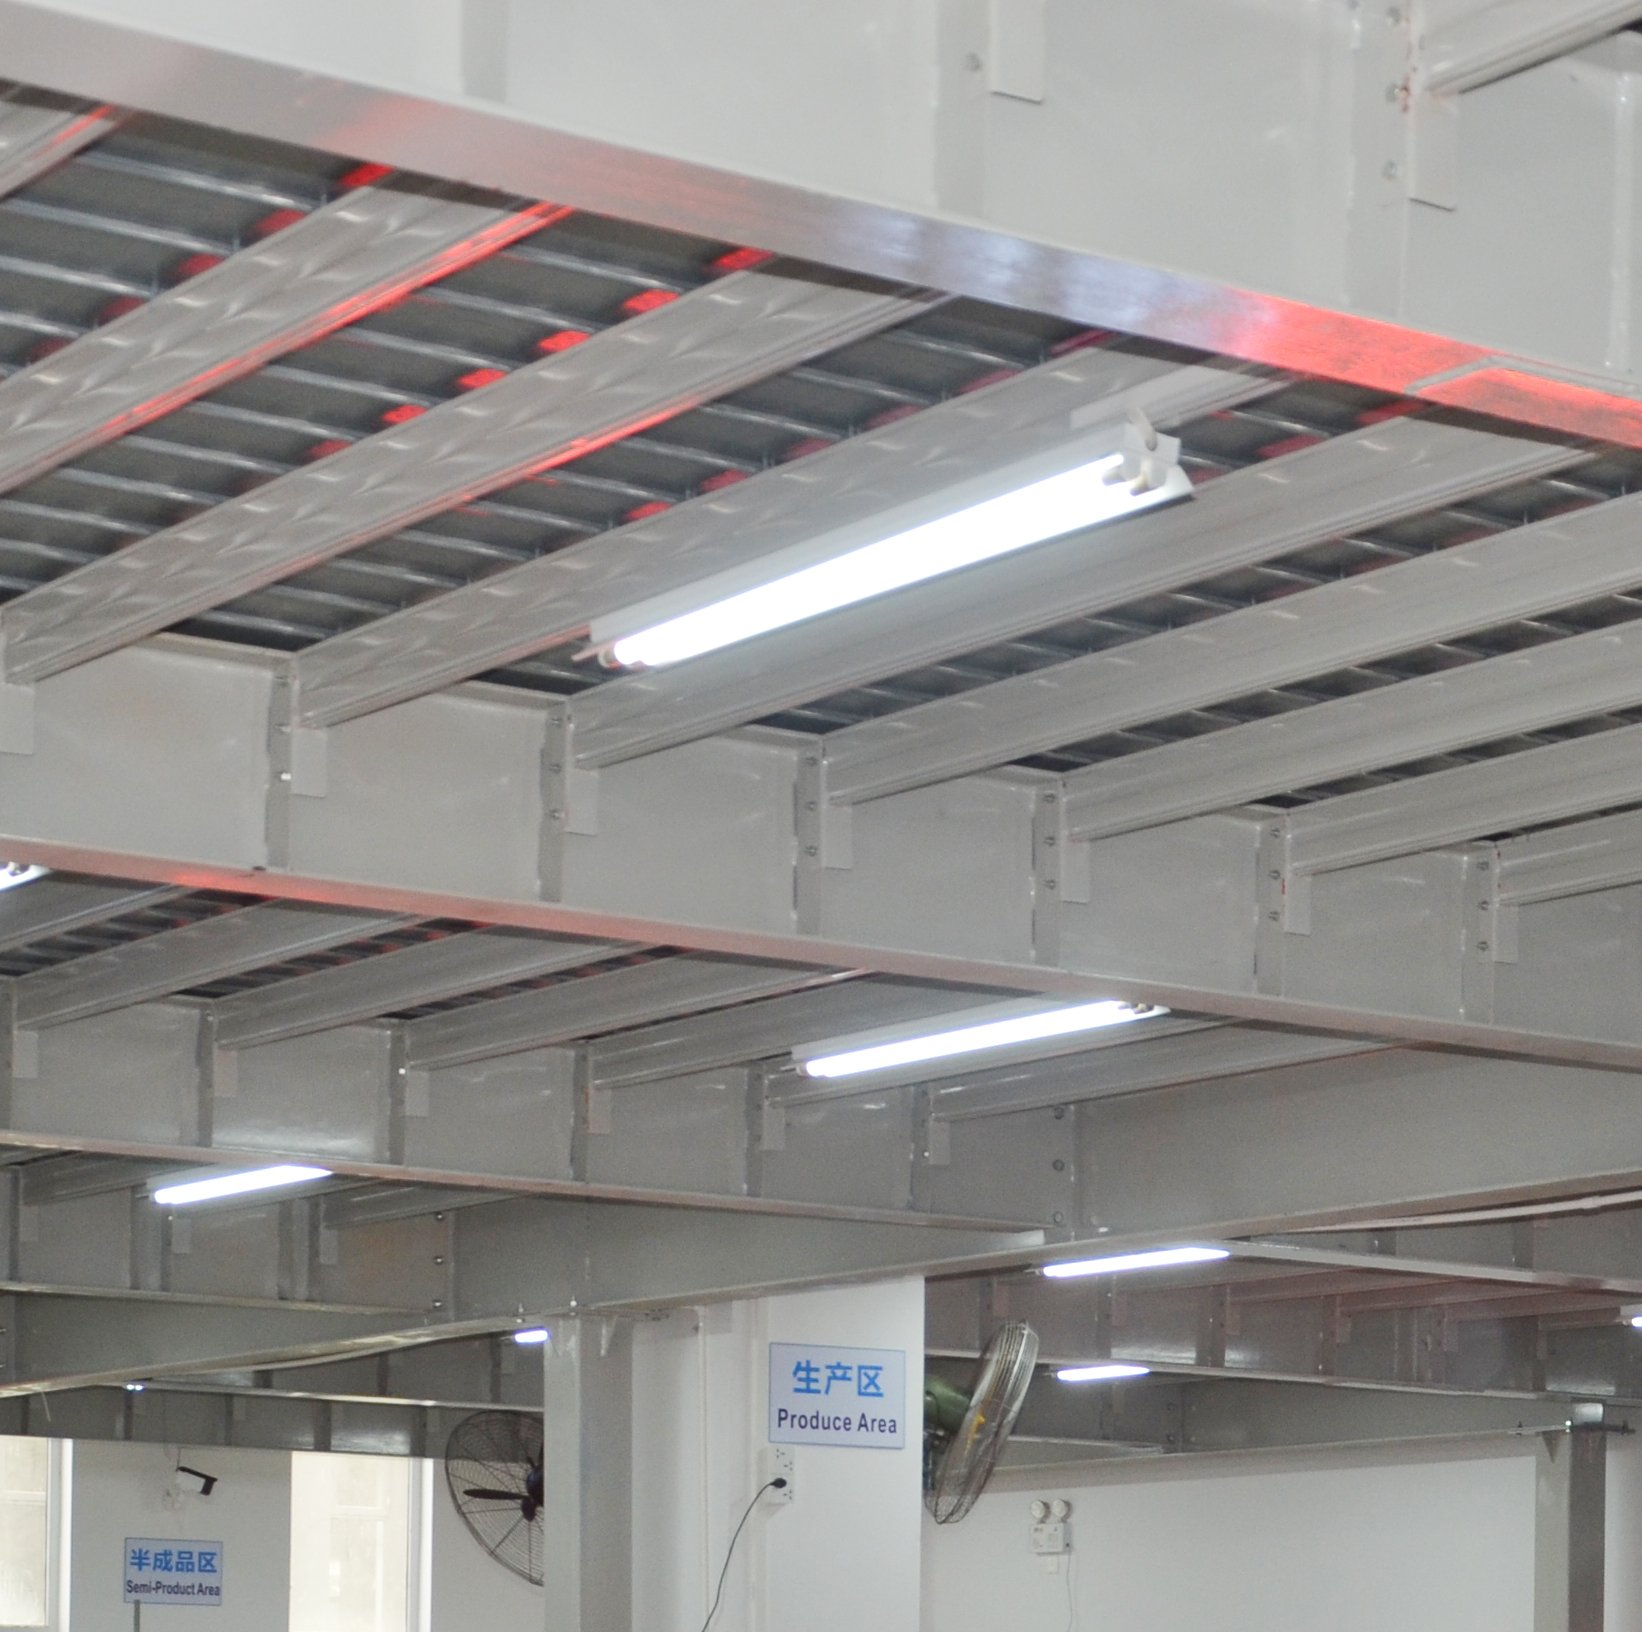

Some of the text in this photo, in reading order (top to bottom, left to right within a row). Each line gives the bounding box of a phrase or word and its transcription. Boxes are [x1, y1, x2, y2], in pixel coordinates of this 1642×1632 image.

[792, 1360, 884, 1397] 生产区
[777, 1408, 897, 1434] Produce Area
[130, 1548, 217, 1573] 半成品区
[126, 1580, 221, 1596] Semi-Product Area
